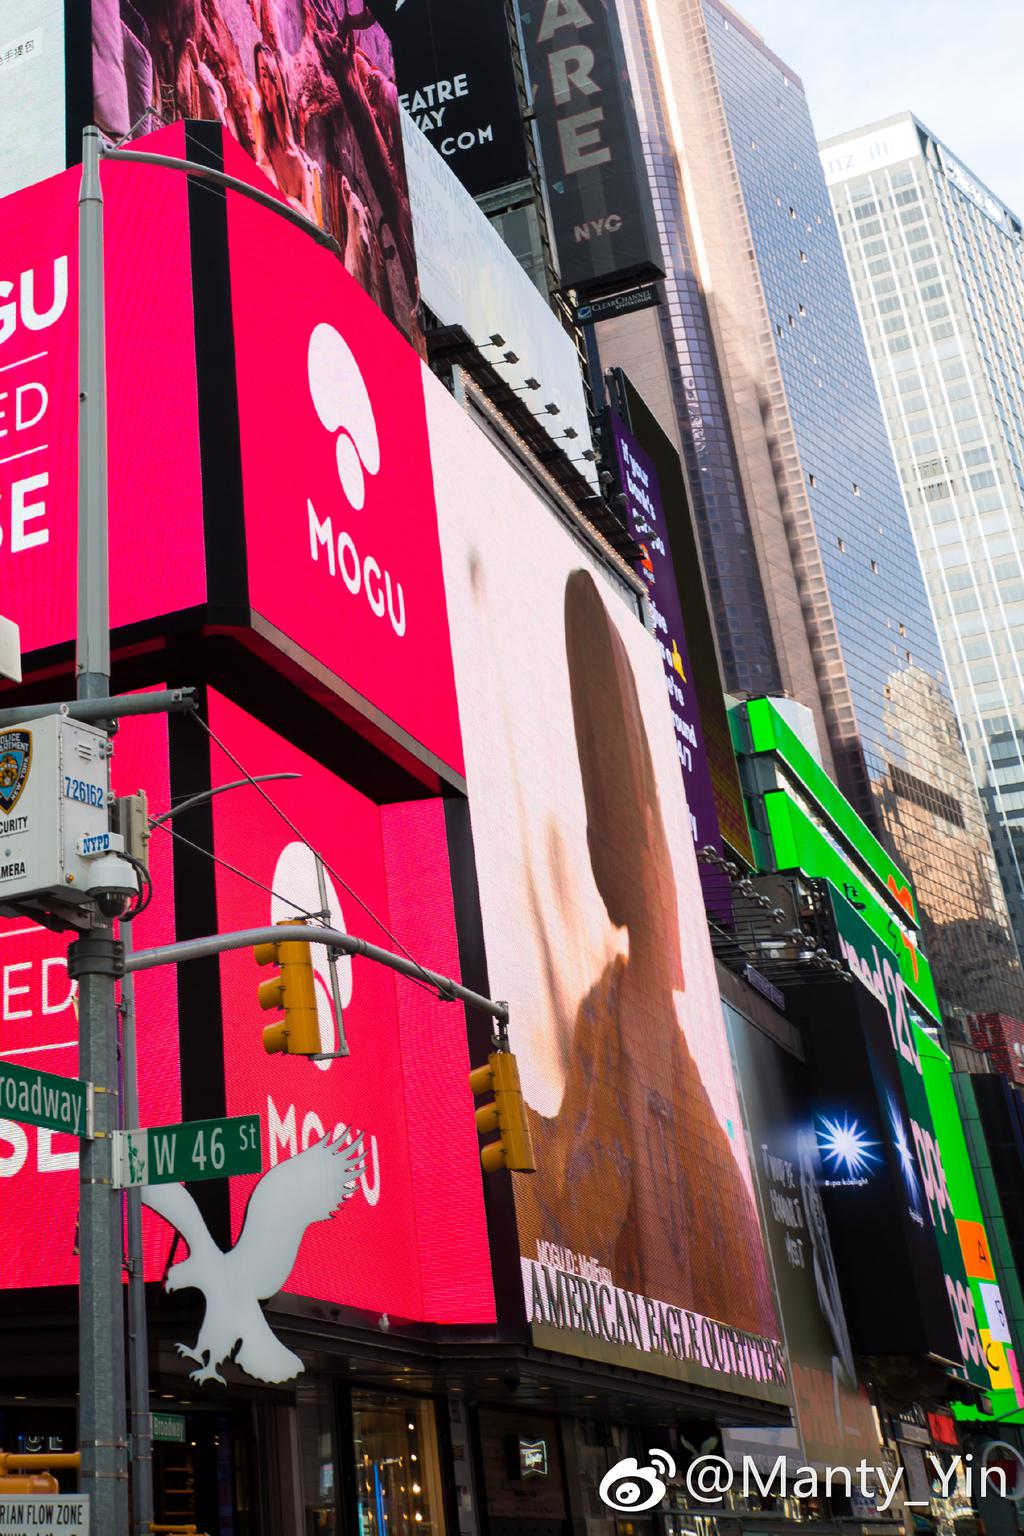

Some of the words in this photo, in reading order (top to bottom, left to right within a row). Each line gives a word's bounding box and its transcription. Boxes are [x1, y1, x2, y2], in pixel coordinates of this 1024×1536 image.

[397, 73, 469, 114] EATRE
[440, 124, 494, 155] COM
[573, 213, 623, 243] NYC
[306, 497, 406, 637] MOGU
[64, 776, 104, 809] 7-26162
[82, 832, 110, 854] NYPD
[153, 1133, 177, 1176] W
[191, 1127, 226, 1172] 46
[239, 1123, 257, 1151] St
[531, 1261, 644, 1352] AMERICAN
[643, 1295, 701, 1362] EAGLE
[153, 1416, 184, 1442] Broadway
[27, 1504, 54, 1525] FLOW
[56, 1504, 83, 1525] ZONE
